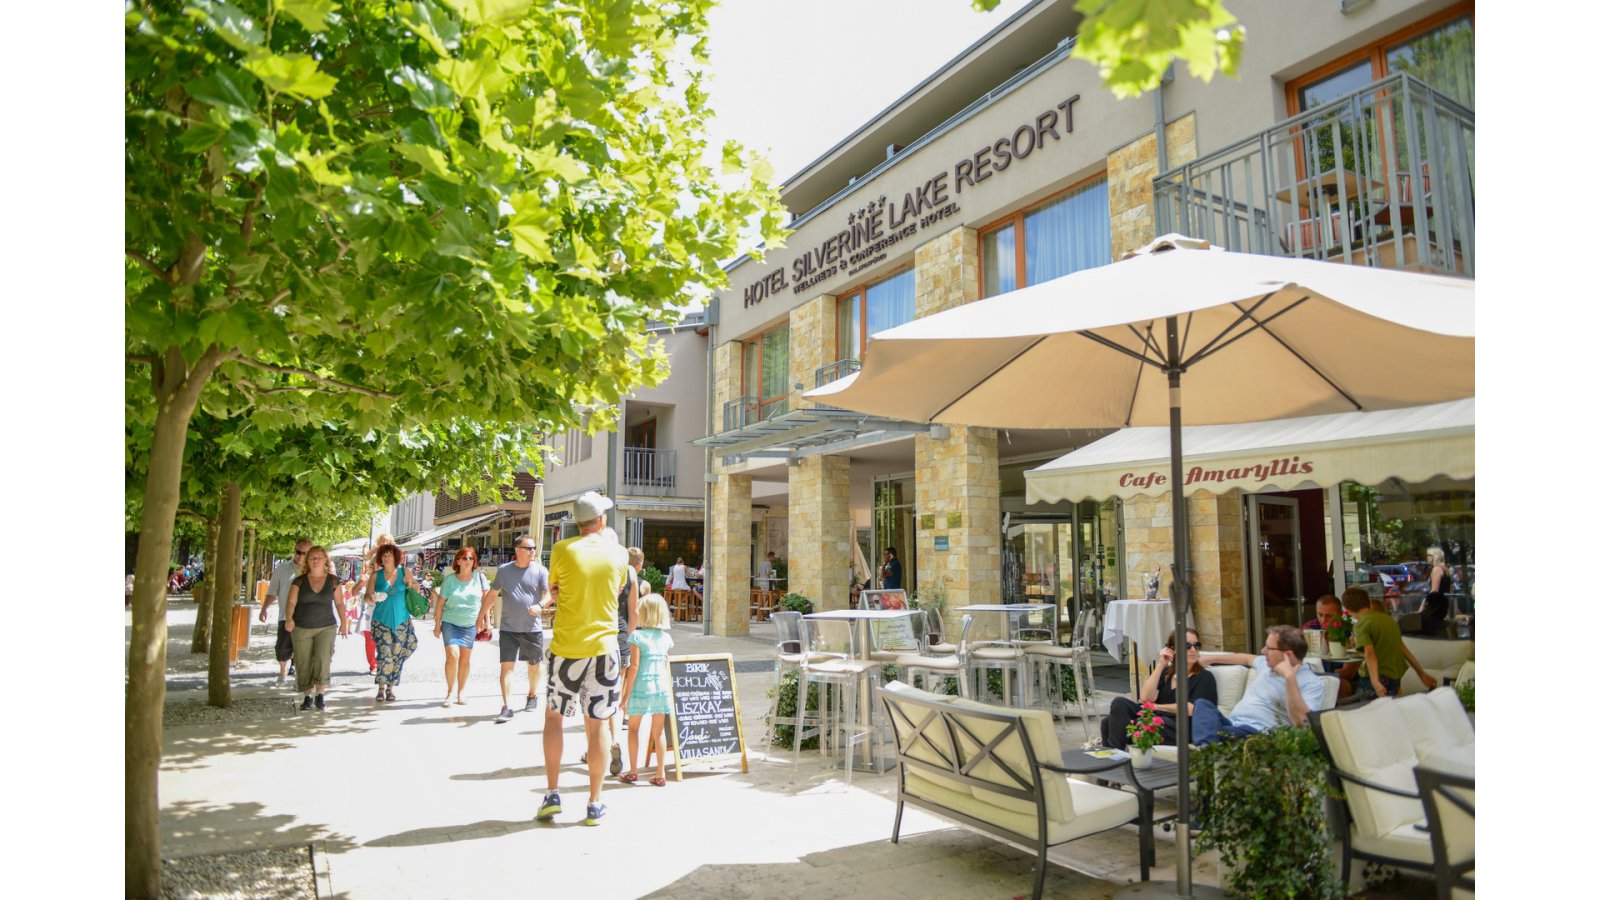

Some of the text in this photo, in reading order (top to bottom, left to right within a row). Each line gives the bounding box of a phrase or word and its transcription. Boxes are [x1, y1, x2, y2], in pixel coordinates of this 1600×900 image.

[744, 93, 1081, 309] HOTEL SILVERINE LAKE RESORT
[792, 266, 838, 295] WELLNESS
[849, 222, 917, 267] CONFERENCE
[920, 202, 961, 229] HOTEL
[1119, 455, 1314, 489] Cafe Amaryllis
[675, 700, 722, 715] LISZKAY
